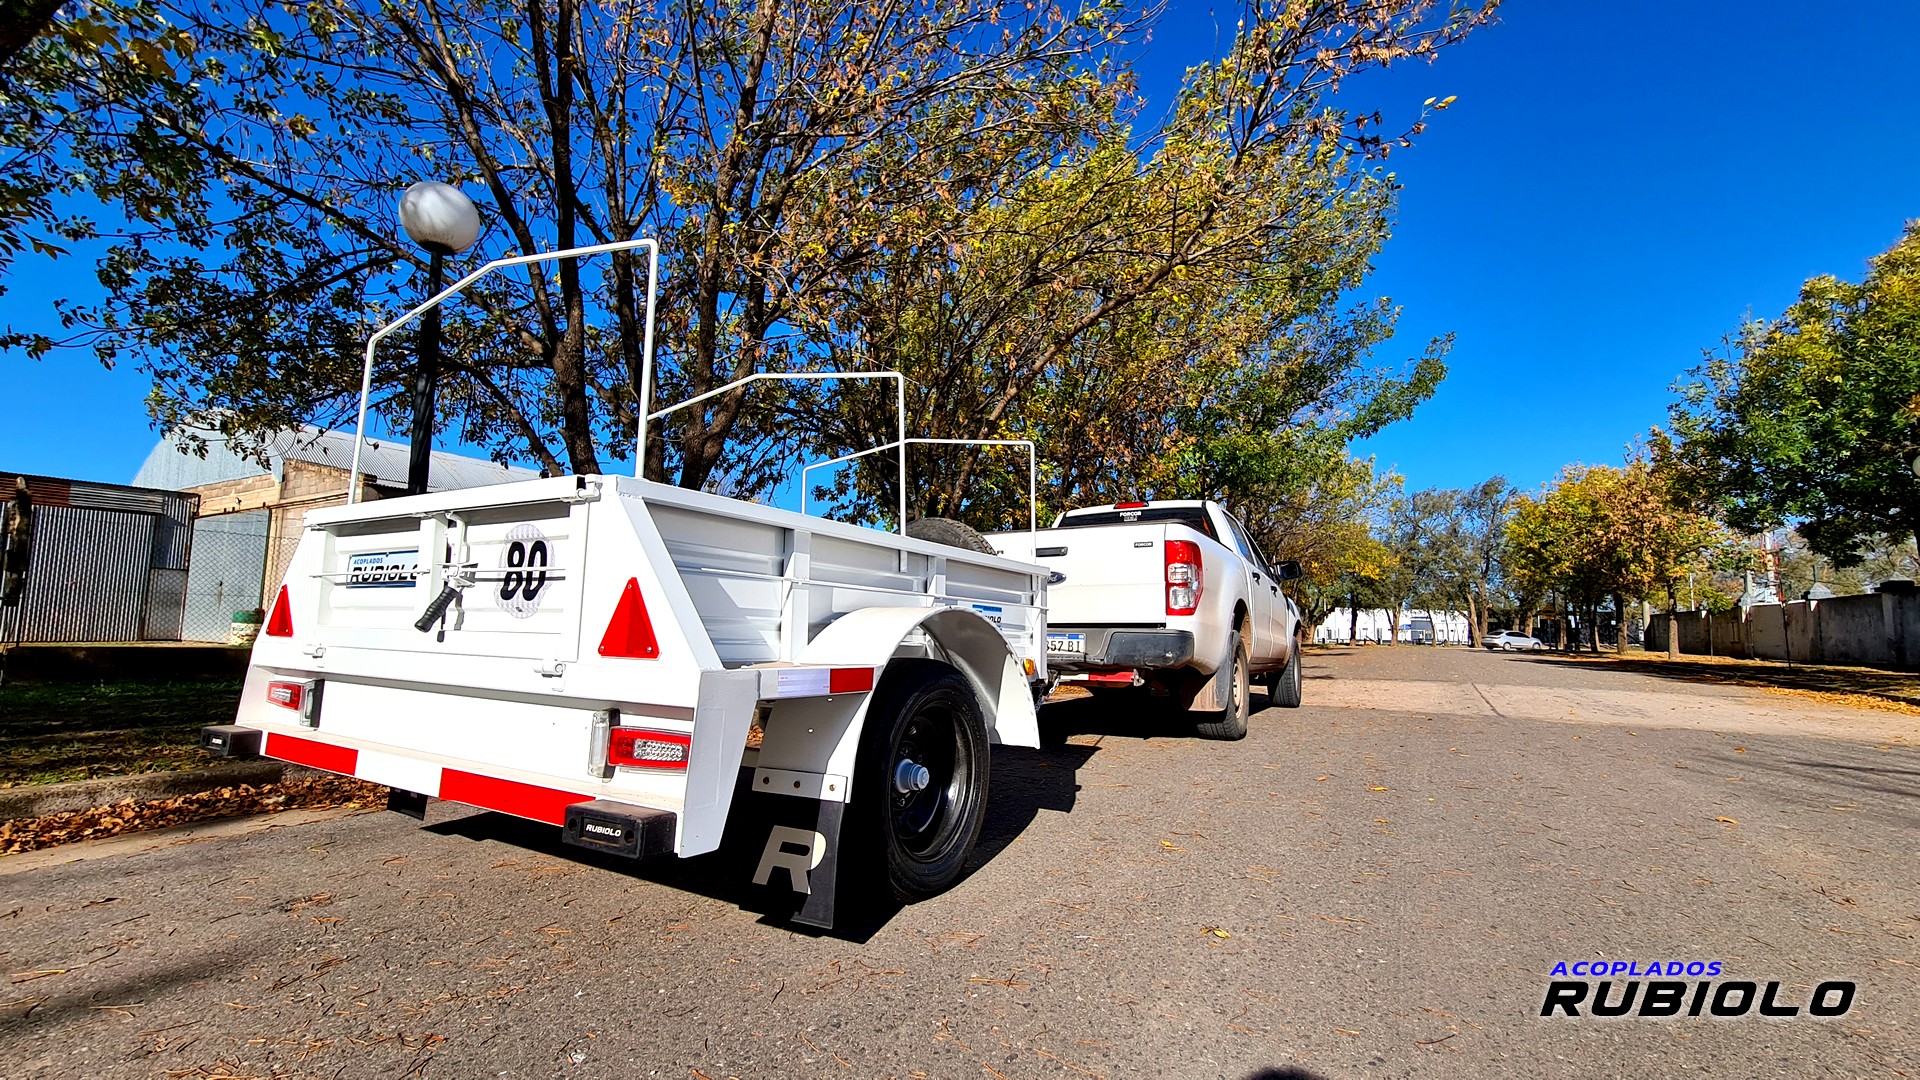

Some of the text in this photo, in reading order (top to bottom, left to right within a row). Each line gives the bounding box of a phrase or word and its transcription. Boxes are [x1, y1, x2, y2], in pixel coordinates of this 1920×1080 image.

[500, 540, 547, 601] 80
[1067, 640, 1081, 653] BI
[585, 824, 622, 837] RUBIOLO
[752, 825, 827, 895] R
